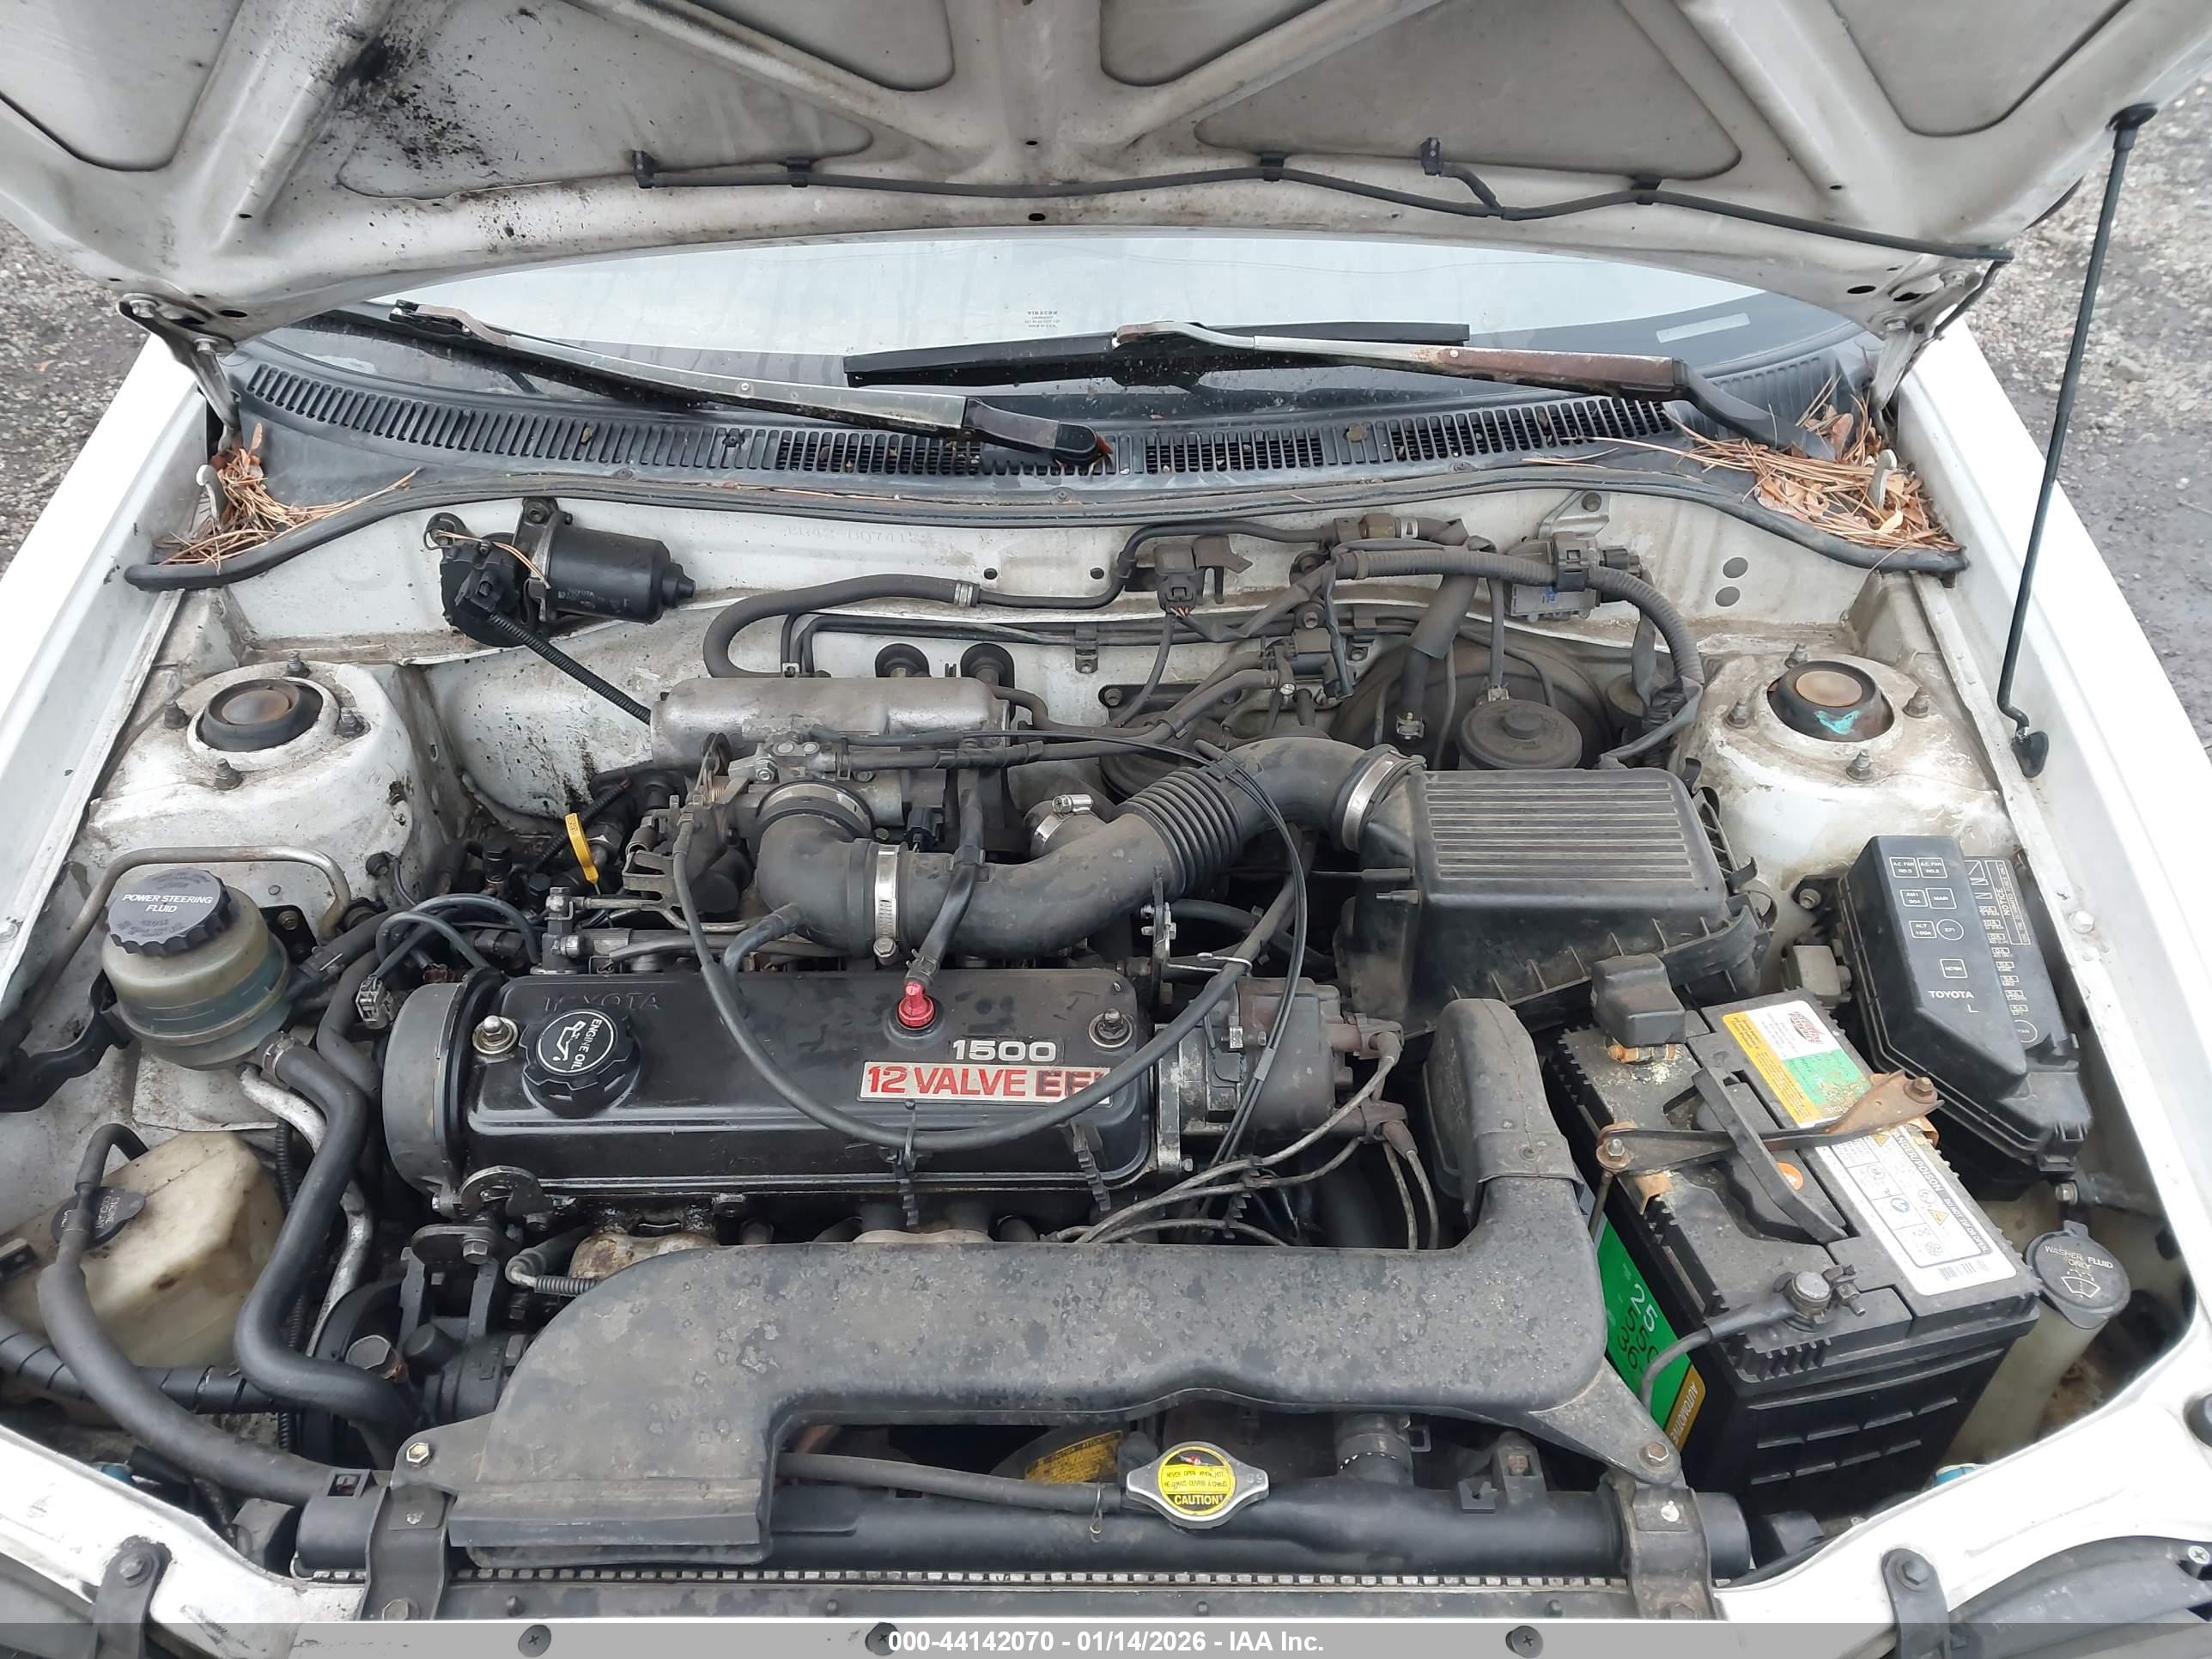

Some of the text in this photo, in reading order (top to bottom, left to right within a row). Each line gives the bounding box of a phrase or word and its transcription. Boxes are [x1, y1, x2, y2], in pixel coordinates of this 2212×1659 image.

[122, 893, 214, 904] POWER STEERING
[145, 904, 178, 913] FLUID
[1996, 887, 2011, 916] NOTICE
[1928, 990, 1975, 1000] TOYOTA
[1967, 1004, 1979, 1013] L
[570, 1018, 603, 1070] ENGINE OIL
[951, 1039, 1057, 1062] 1500
[867, 1065, 908, 1093] 12
[914, 1066, 1027, 1097] VALVE
[2045, 1245, 2114, 1269] WASHER FLUID
[2068, 1258, 2092, 1270] ONLY
[1630, 1283, 1658, 1333] 25
